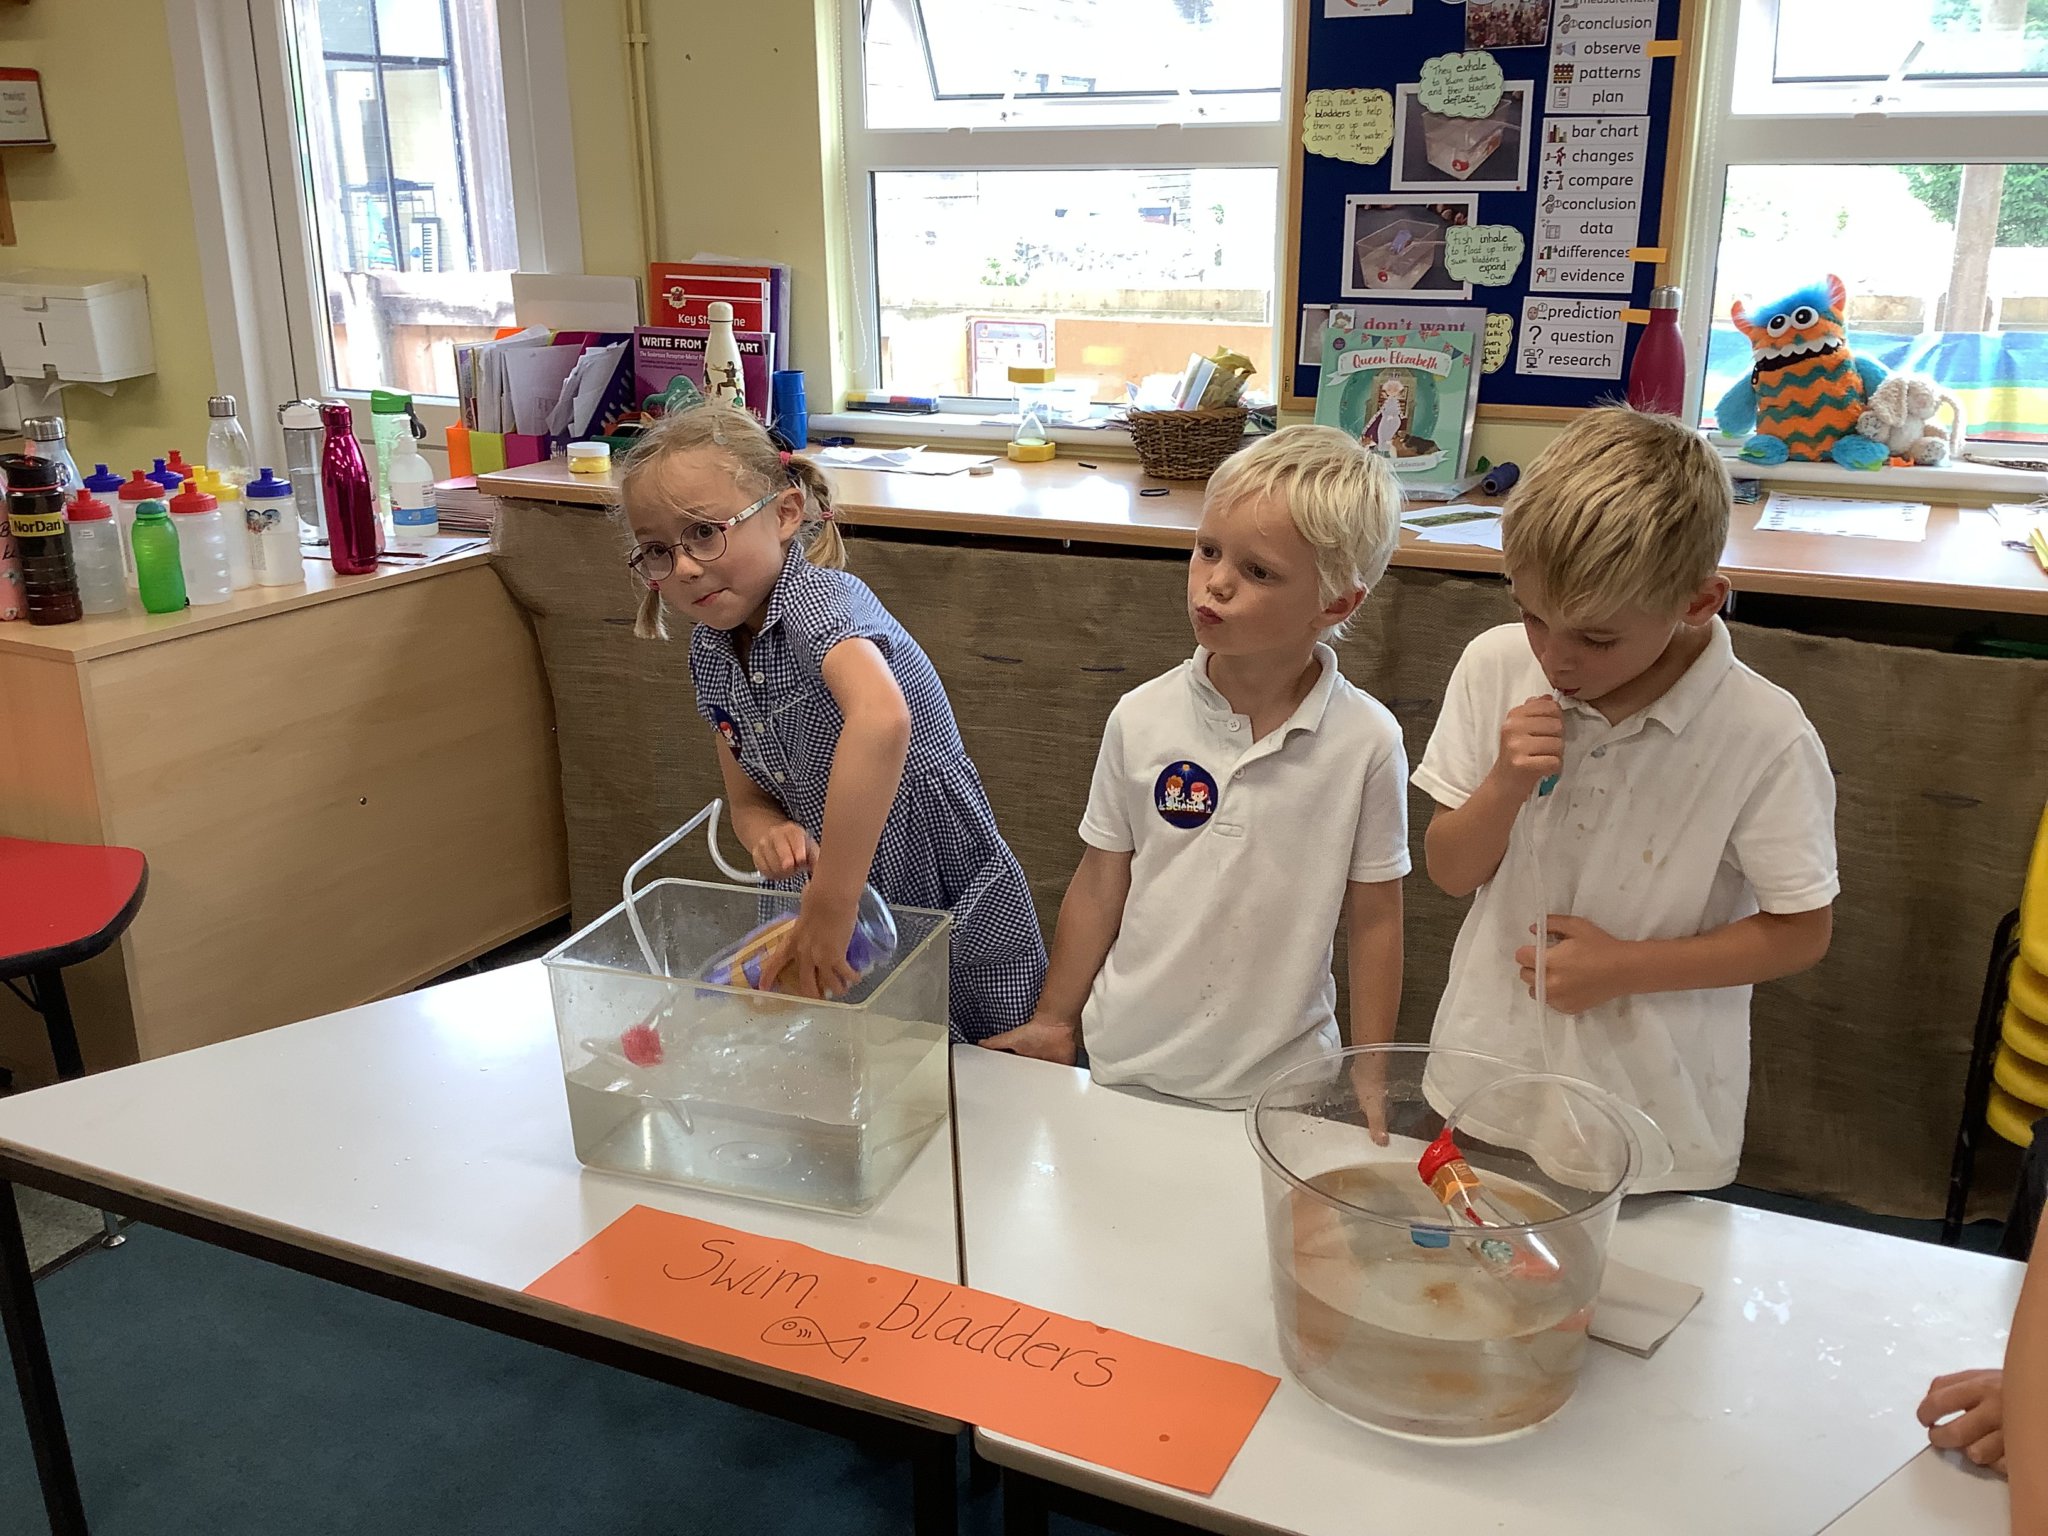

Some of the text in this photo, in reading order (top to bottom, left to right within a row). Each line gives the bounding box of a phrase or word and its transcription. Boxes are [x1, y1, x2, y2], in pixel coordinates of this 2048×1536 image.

[1578, 16, 1652, 30] conclusion
[1584, 41, 1641, 54] observe
[1456, 58, 1487, 72] exhale
[1579, 66, 1641, 82] patterns
[1592, 89, 1624, 106] plan
[1315, 108, 1350, 118] bladders
[1572, 124, 1639, 138] bar chart
[1572, 149, 1634, 166] changes
[1568, 176, 1634, 190] compare
[1562, 197, 1636, 210] conclusion
[1580, 221, 1613, 234] data
[1558, 244, 1630, 258] differences
[1560, 268, 1625, 282] evidence
[678, 313, 697, 326] Key
[1548, 304, 1622, 321] prediction
[1363, 317, 1466, 331] don't want
[642, 336, 672, 348] WRITE
[674, 339, 701, 349] FROM
[1550, 330, 1614, 345] question
[1353, 350, 1438, 369] Queen Elizabeth
[1548, 354, 1611, 367] research
[13, 519, 62, 533] NorDan
[663, 1239, 1117, 1388] Swim bladders
